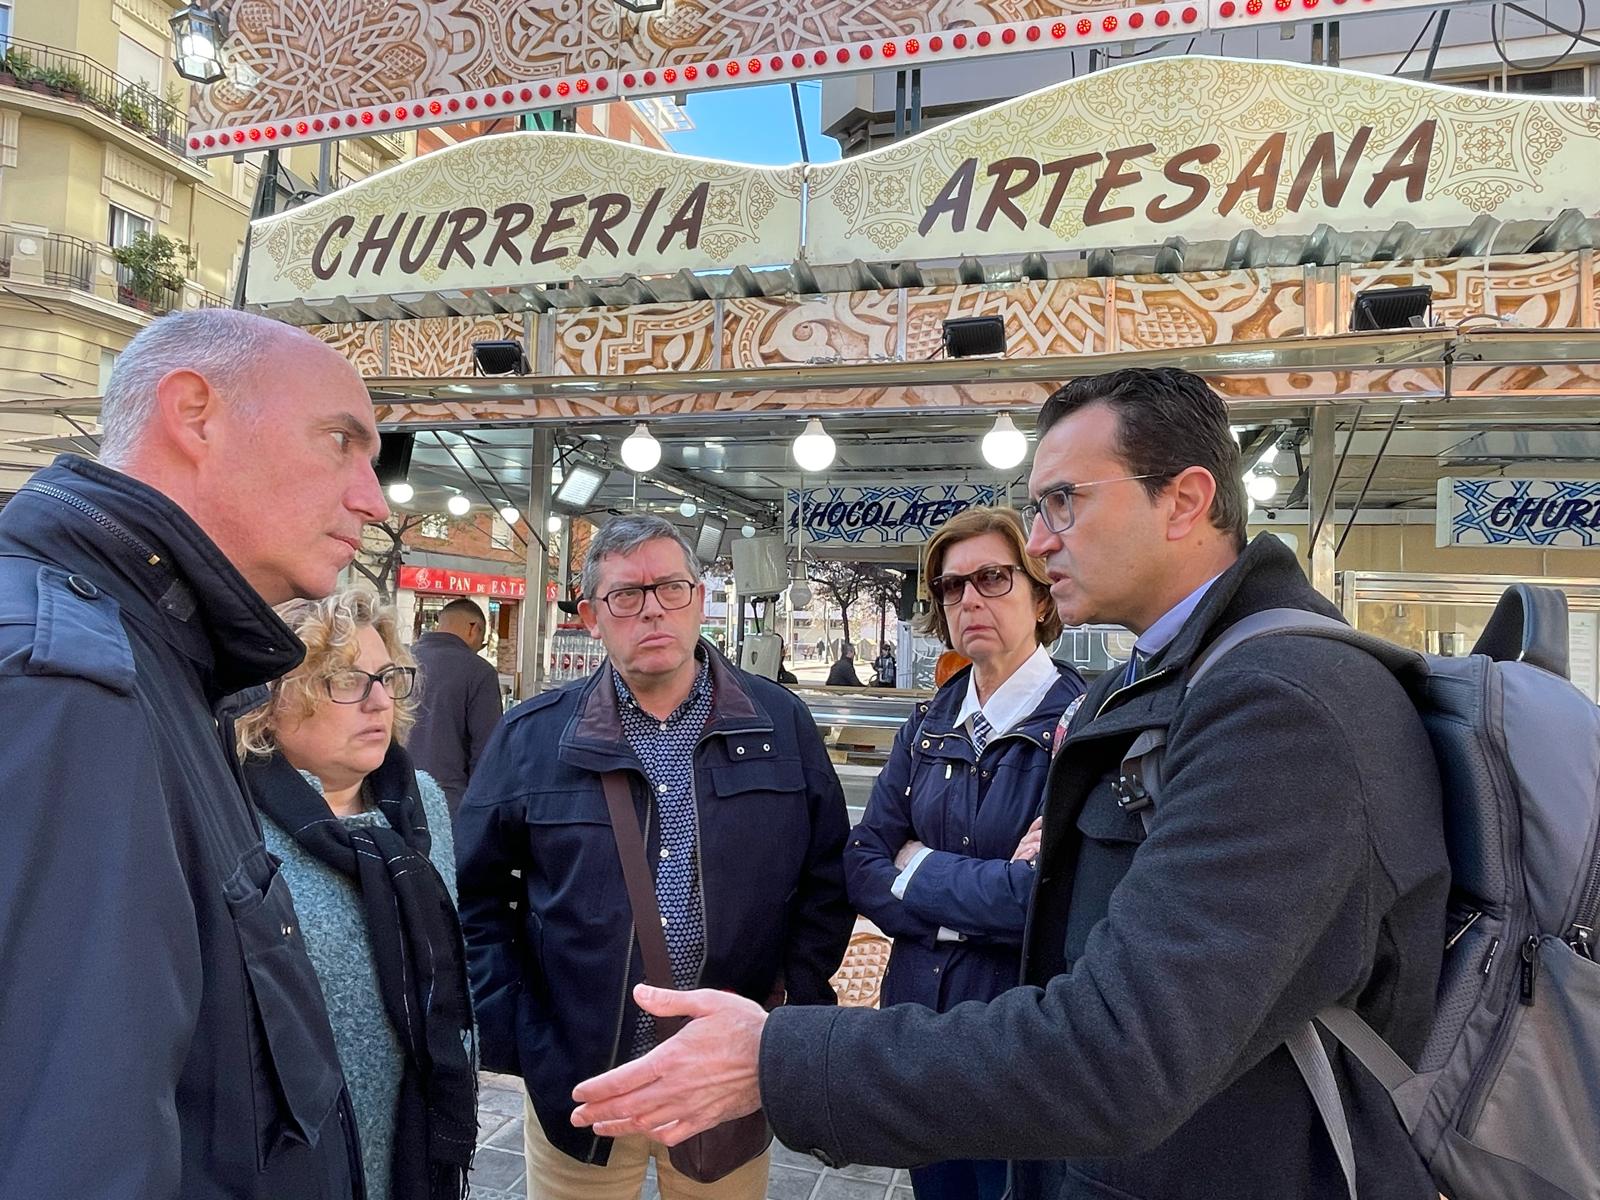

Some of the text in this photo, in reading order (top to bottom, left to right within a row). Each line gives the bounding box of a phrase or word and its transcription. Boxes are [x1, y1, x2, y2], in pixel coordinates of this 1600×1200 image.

[311, 119, 1437, 281] CHURRERIA ARTESANA
[790, 500, 973, 528] CHOCOLATER
[434, 580, 443, 589] EL
[450, 576, 471, 592] PAN
[476, 583, 485, 593] DE
